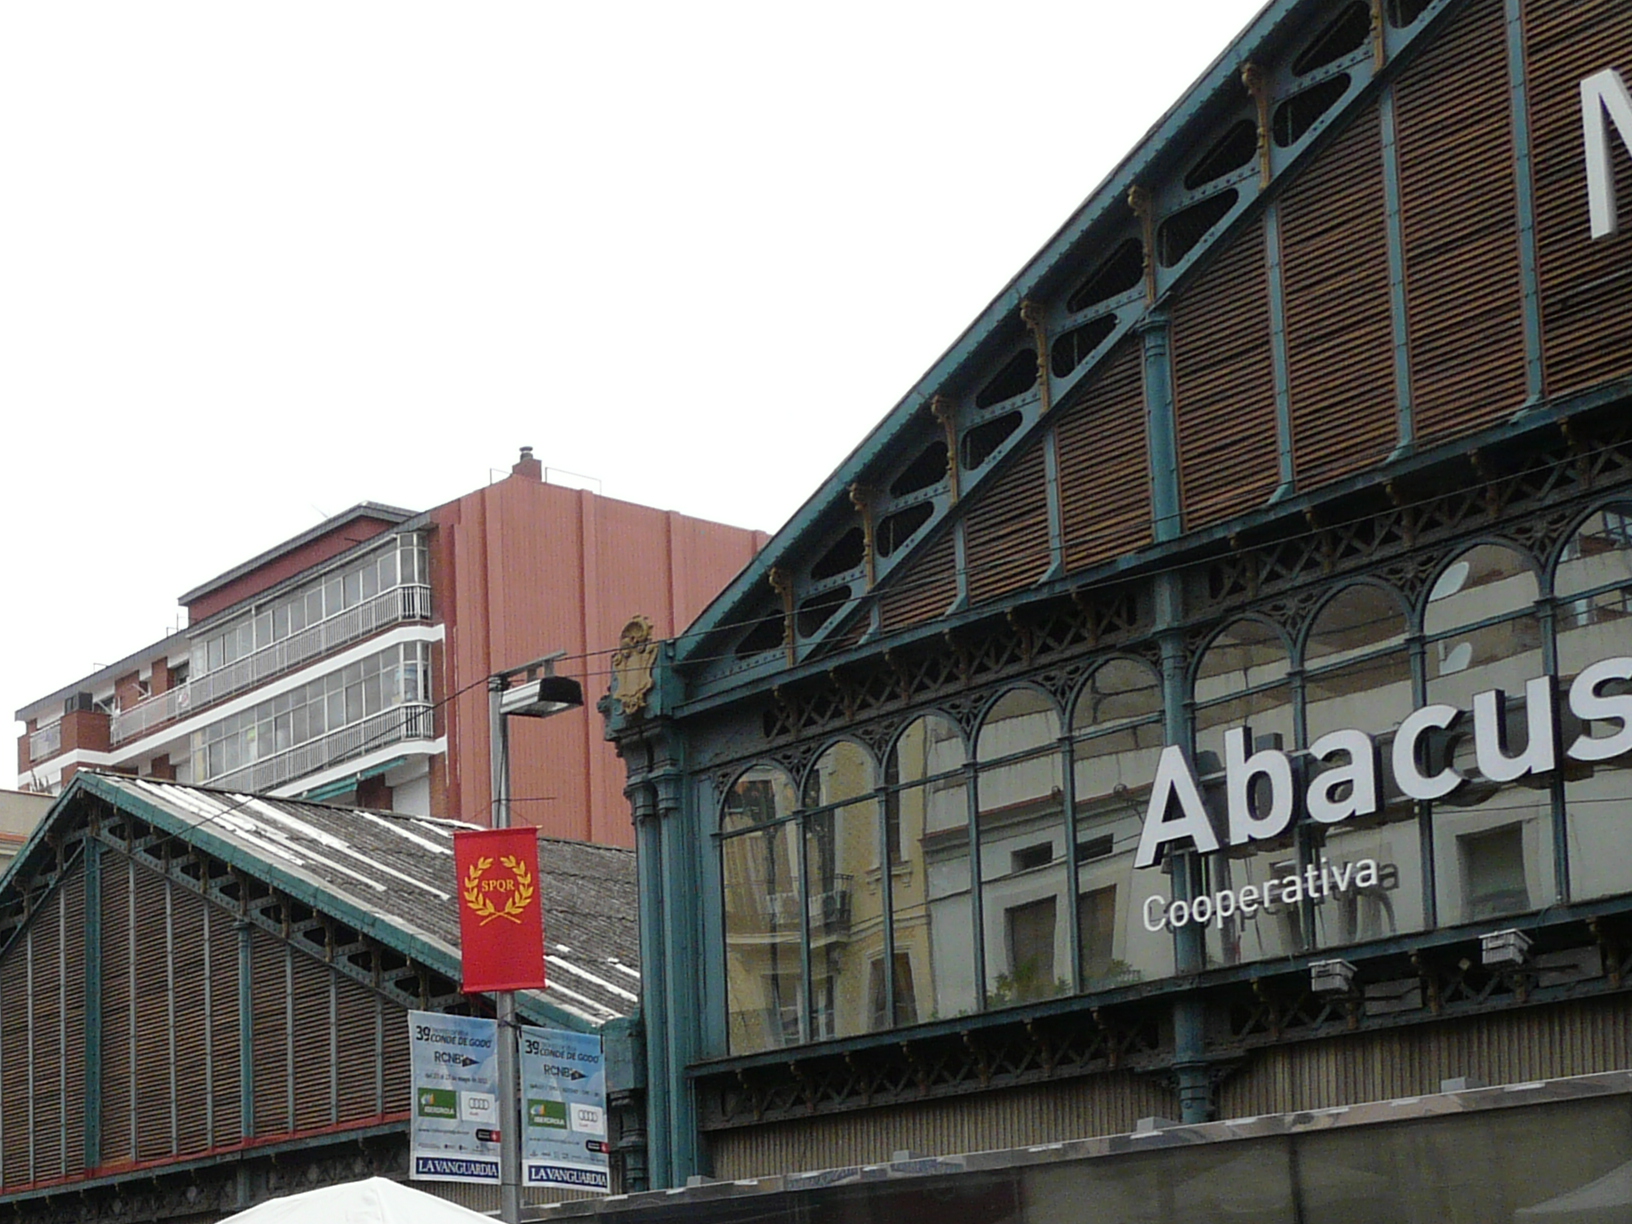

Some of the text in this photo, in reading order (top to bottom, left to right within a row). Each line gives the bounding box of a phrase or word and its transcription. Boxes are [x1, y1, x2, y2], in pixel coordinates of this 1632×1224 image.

[1134, 656, 1632, 869] Abacus
[481, 878, 515, 893] SPQR
[1142, 857, 1379, 932] Cooperativa
[415, 1025, 431, 1042] 39
[525, 1039, 540, 1055] 39
[418, 1160, 498, 1177] LA VANGUARDIA
[531, 1167, 607, 1187] LA VANGUARDIA
